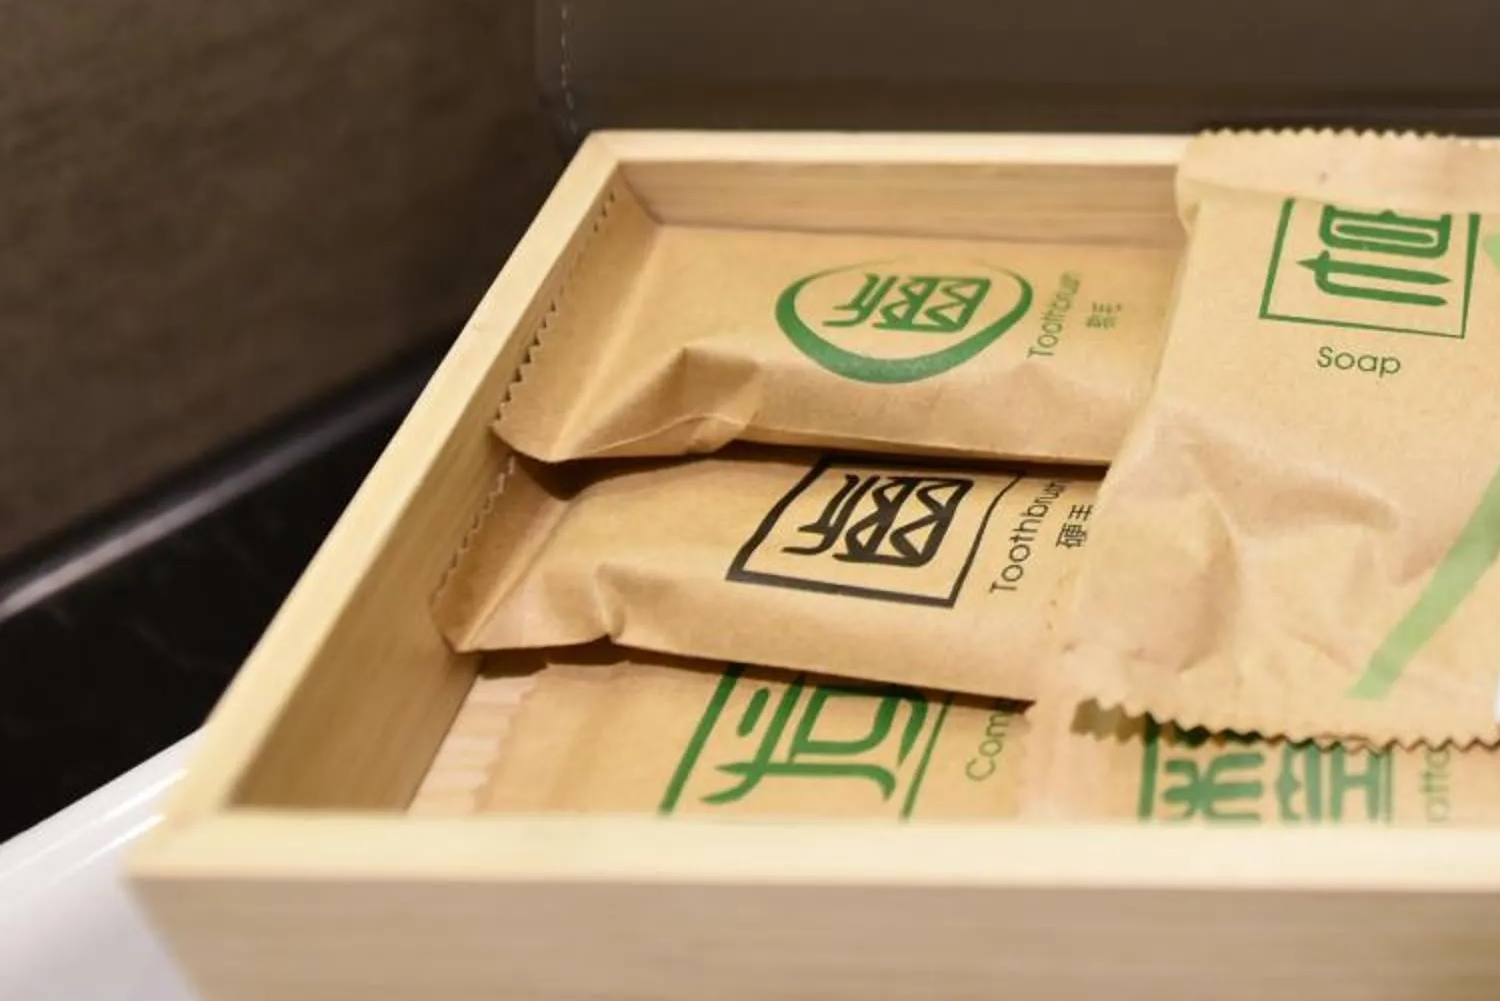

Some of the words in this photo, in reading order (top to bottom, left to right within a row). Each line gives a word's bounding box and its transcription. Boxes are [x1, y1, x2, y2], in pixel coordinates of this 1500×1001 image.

[1317, 345, 1401, 378] Soap
[964, 703, 1013, 783] Com
[1420, 747, 1452, 823] otto
